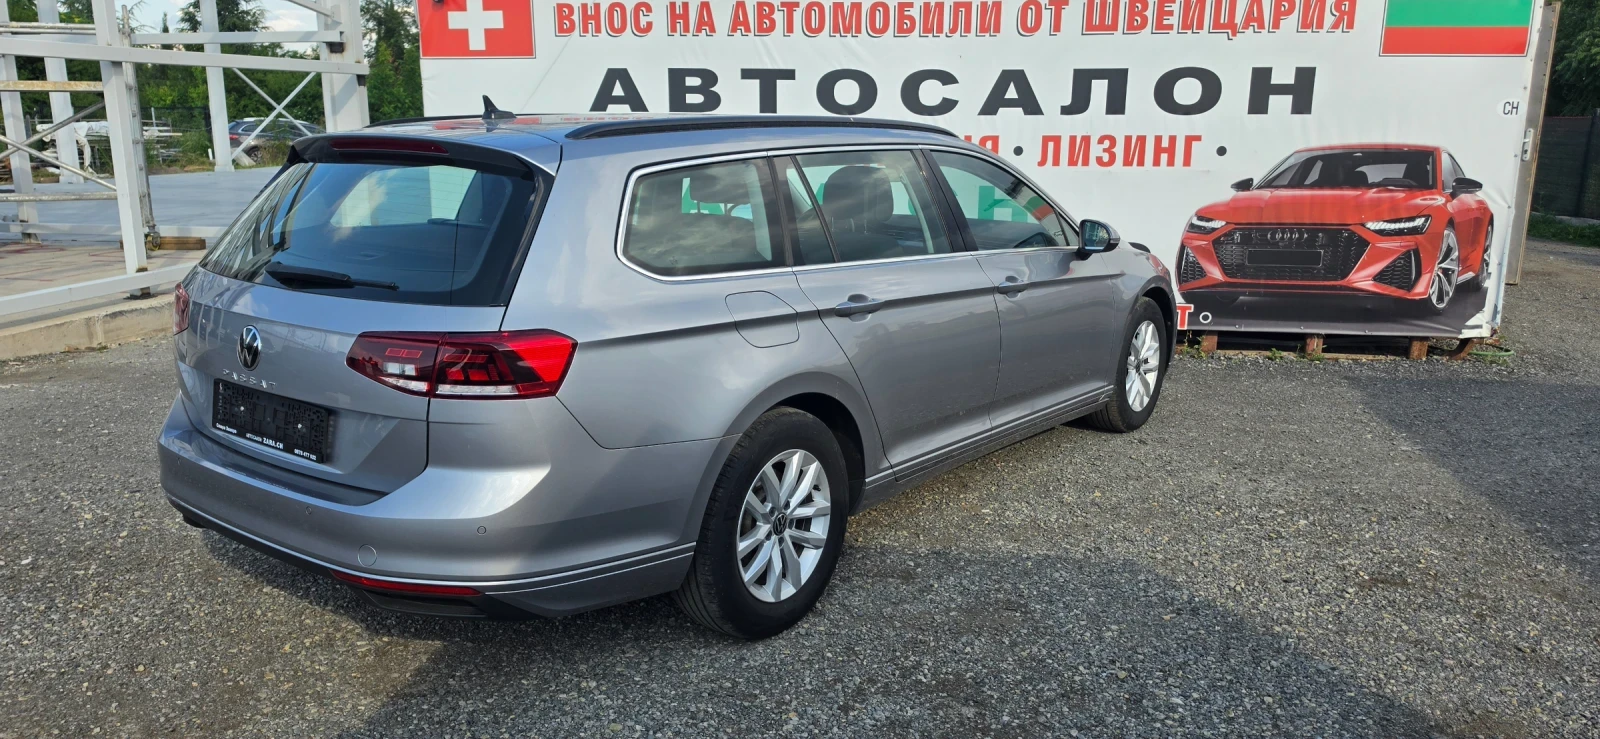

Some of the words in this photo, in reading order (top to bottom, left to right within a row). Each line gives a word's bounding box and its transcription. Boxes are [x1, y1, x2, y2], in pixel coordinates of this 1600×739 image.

[554, 2, 655, 38] ВНОС
[666, 1, 718, 37] НА
[729, 0, 1003, 38] АВТОМОБИЛИ
[1017, 0, 1070, 37] ОТ
[590, 66, 1317, 117] АВТОСАЛОН
[1502, 101, 1519, 115] CH
[1037, 134, 1202, 168] ЛИЗИНГ
